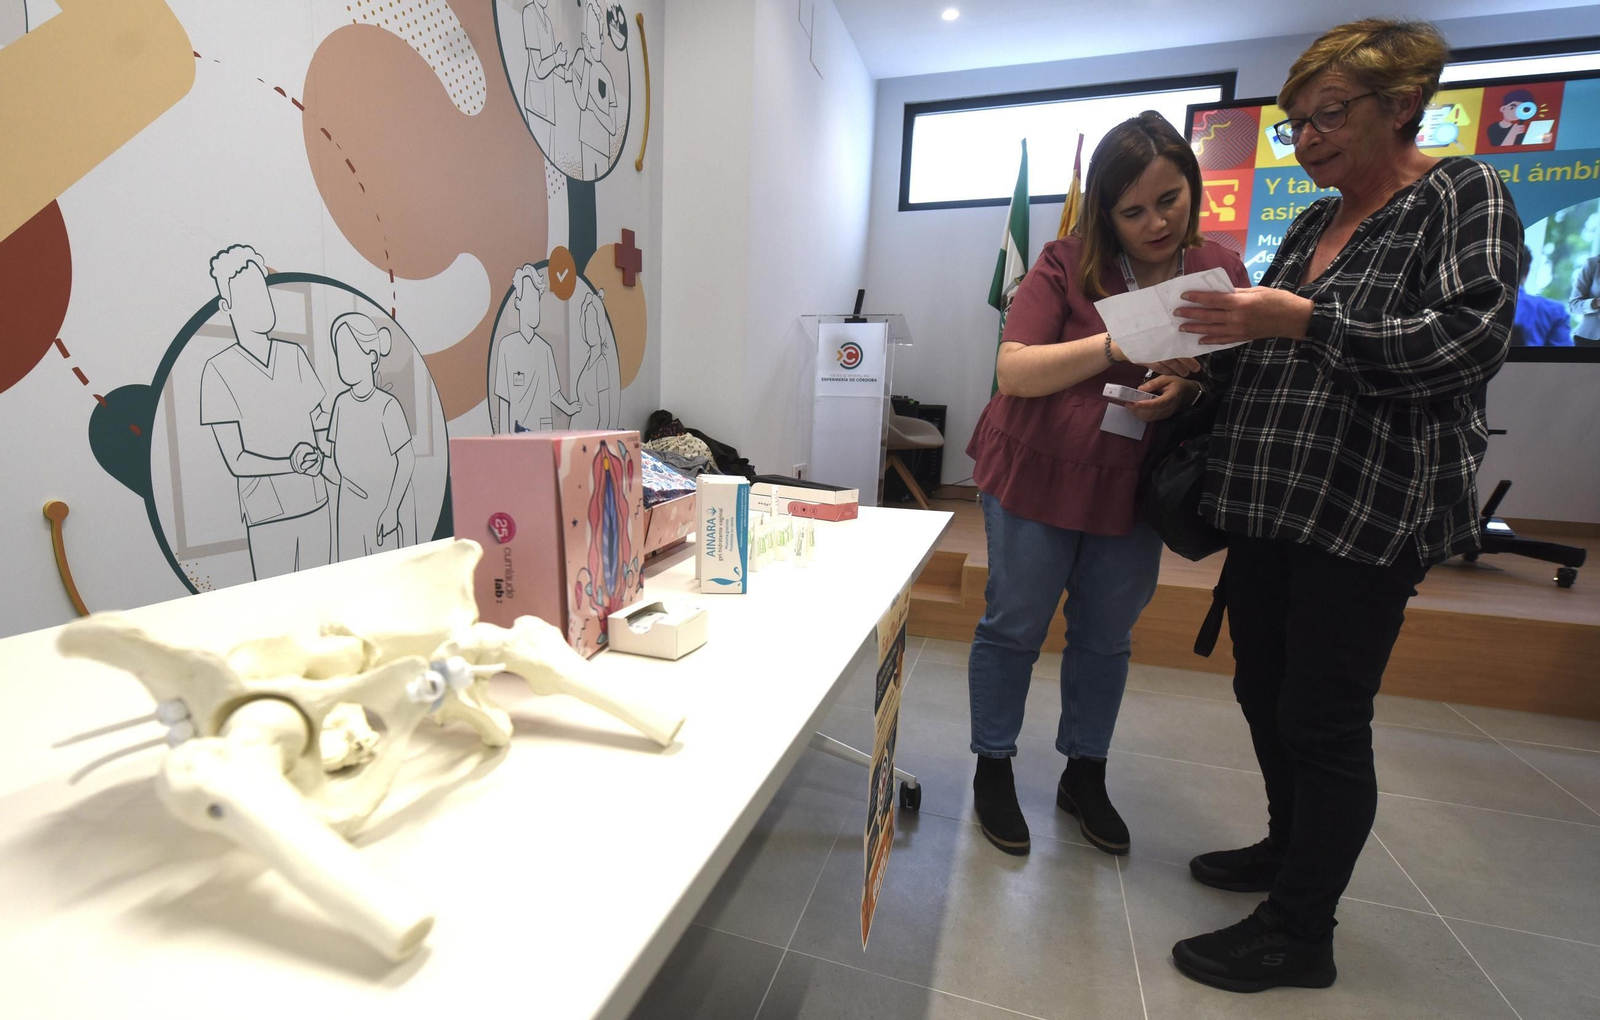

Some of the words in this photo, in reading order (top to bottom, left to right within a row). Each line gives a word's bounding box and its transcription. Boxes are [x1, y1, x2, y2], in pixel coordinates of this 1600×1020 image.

[1265, 178, 1282, 195] Y
[1497, 164, 1521, 183] el
[495, 518, 509, 537] 25
[706, 518, 716, 557] AINARA
[503, 547, 515, 599] cumlaude
